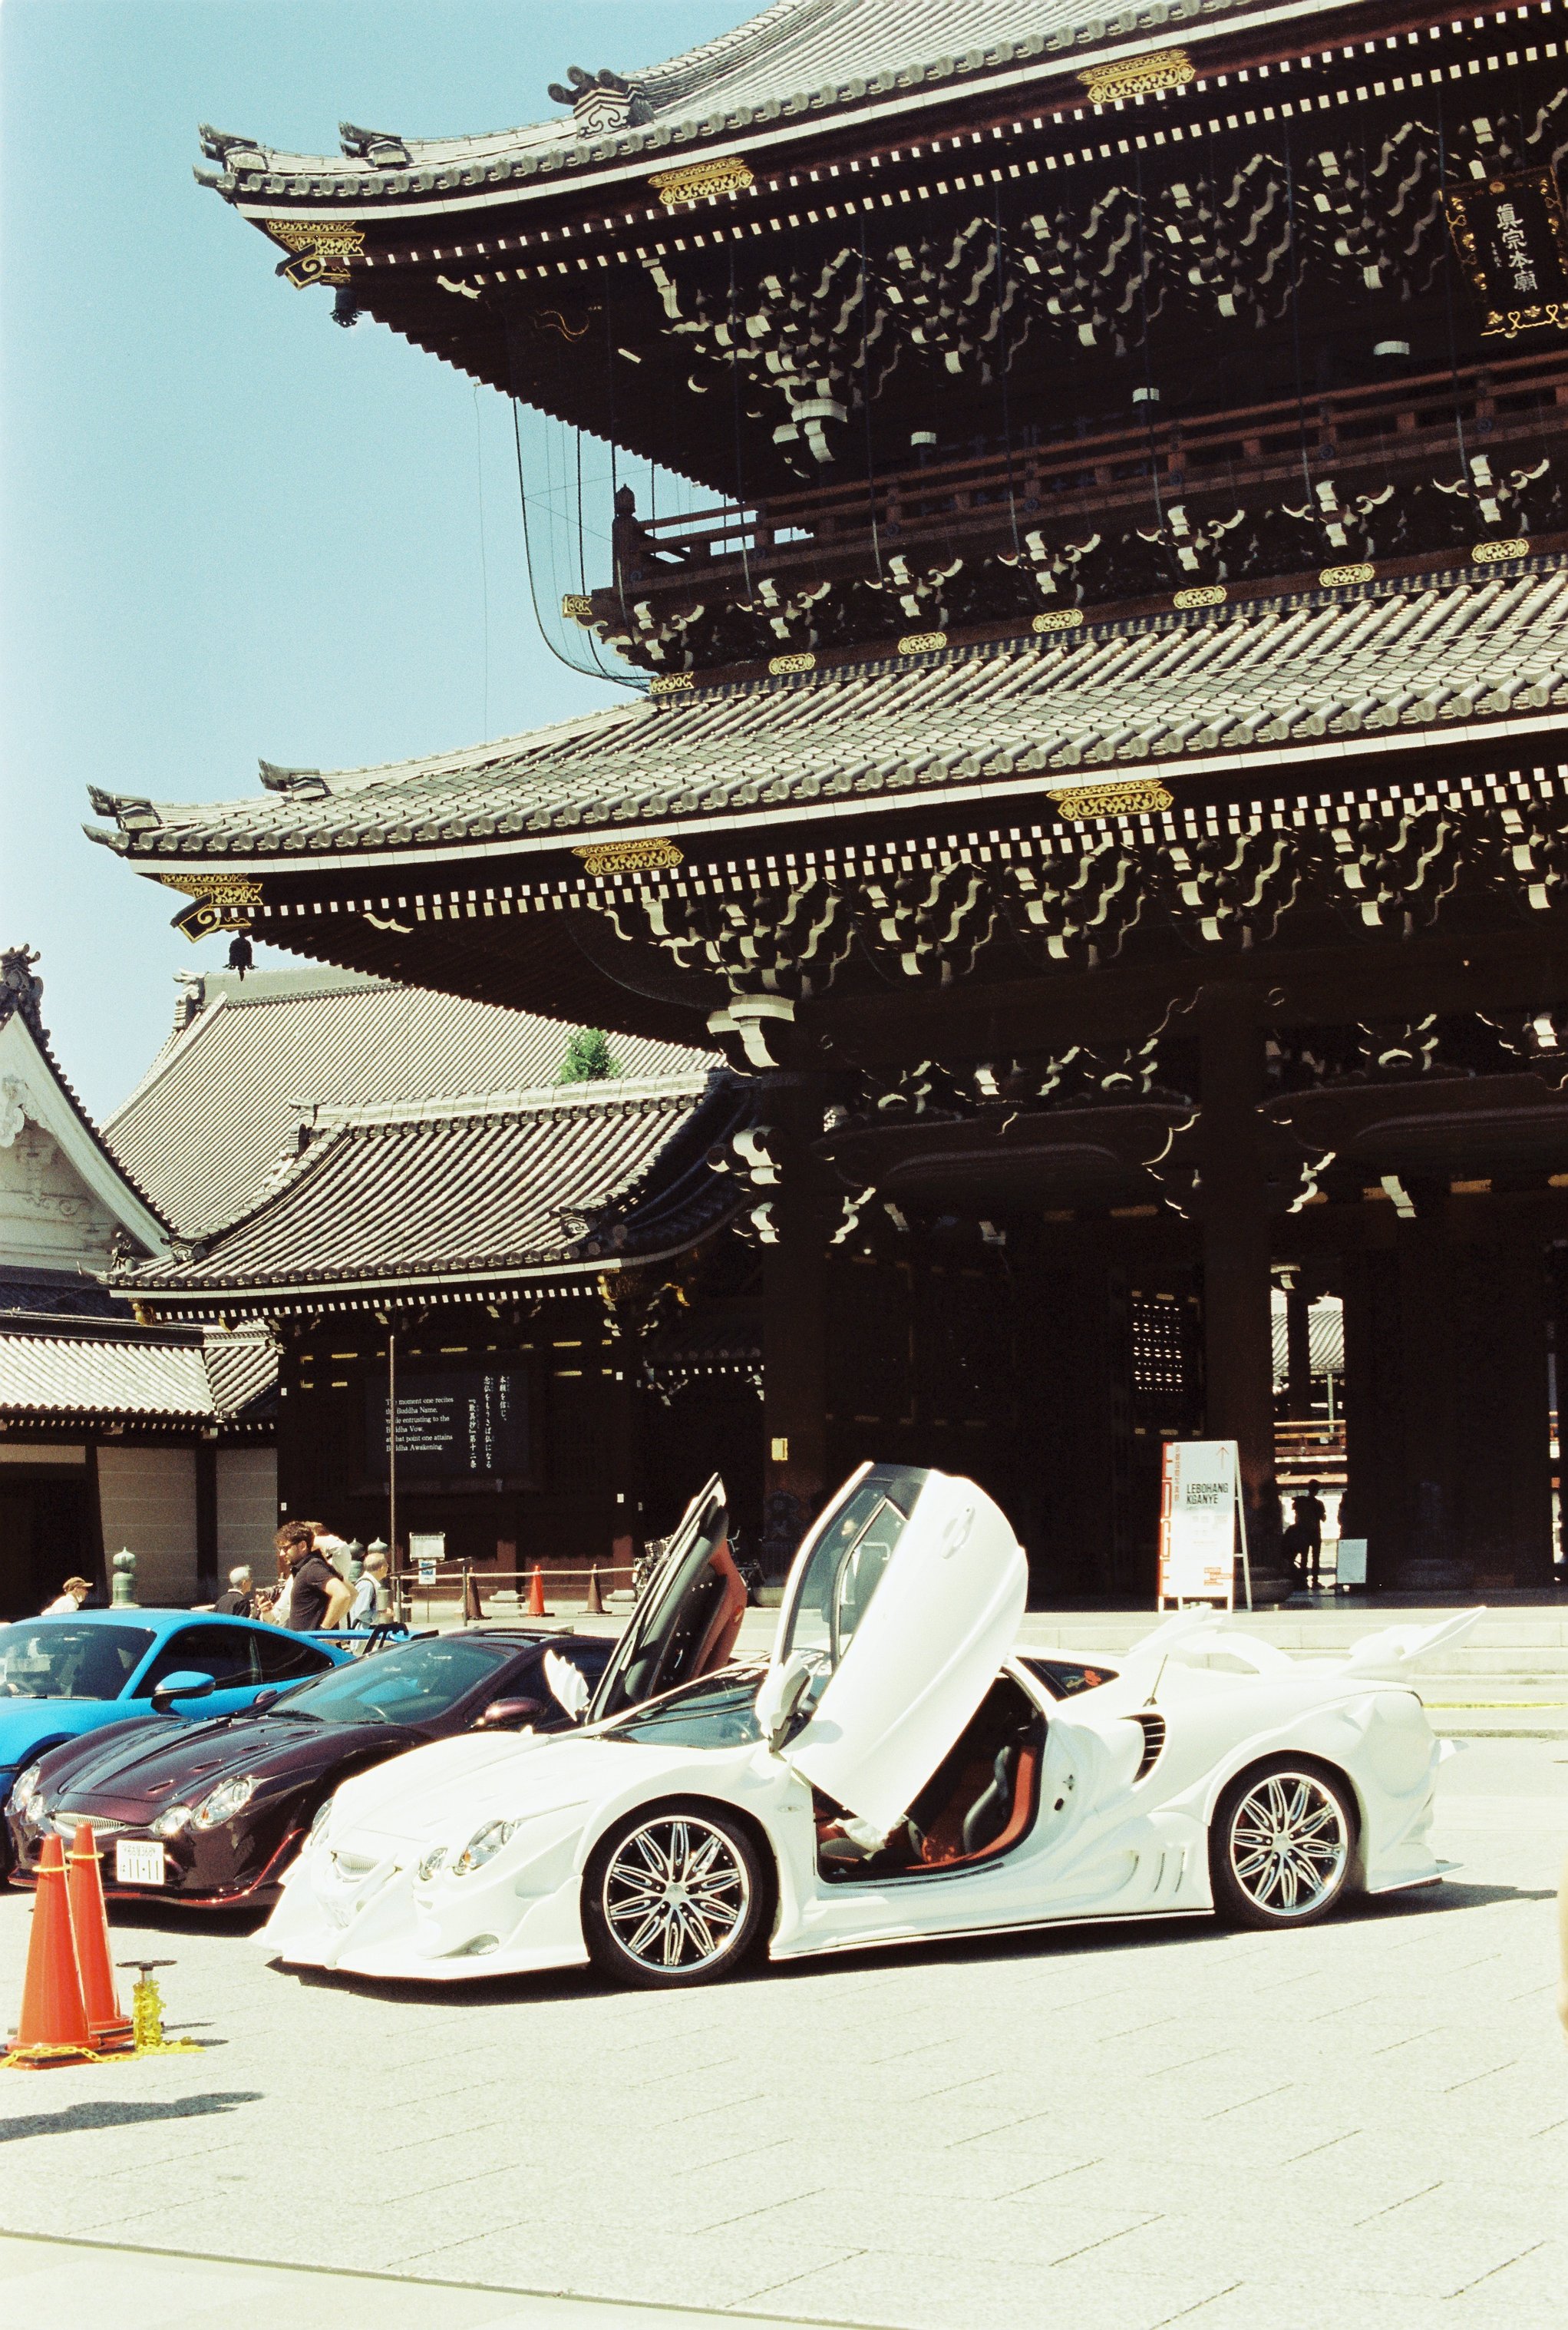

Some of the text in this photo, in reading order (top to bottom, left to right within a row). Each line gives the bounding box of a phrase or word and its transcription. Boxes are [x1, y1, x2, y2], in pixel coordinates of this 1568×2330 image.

[406, 1434, 421, 1443] point
[1187, 1482, 1229, 1494] LEBOHANG
[1187, 1494, 1219, 1505] KGANYE
